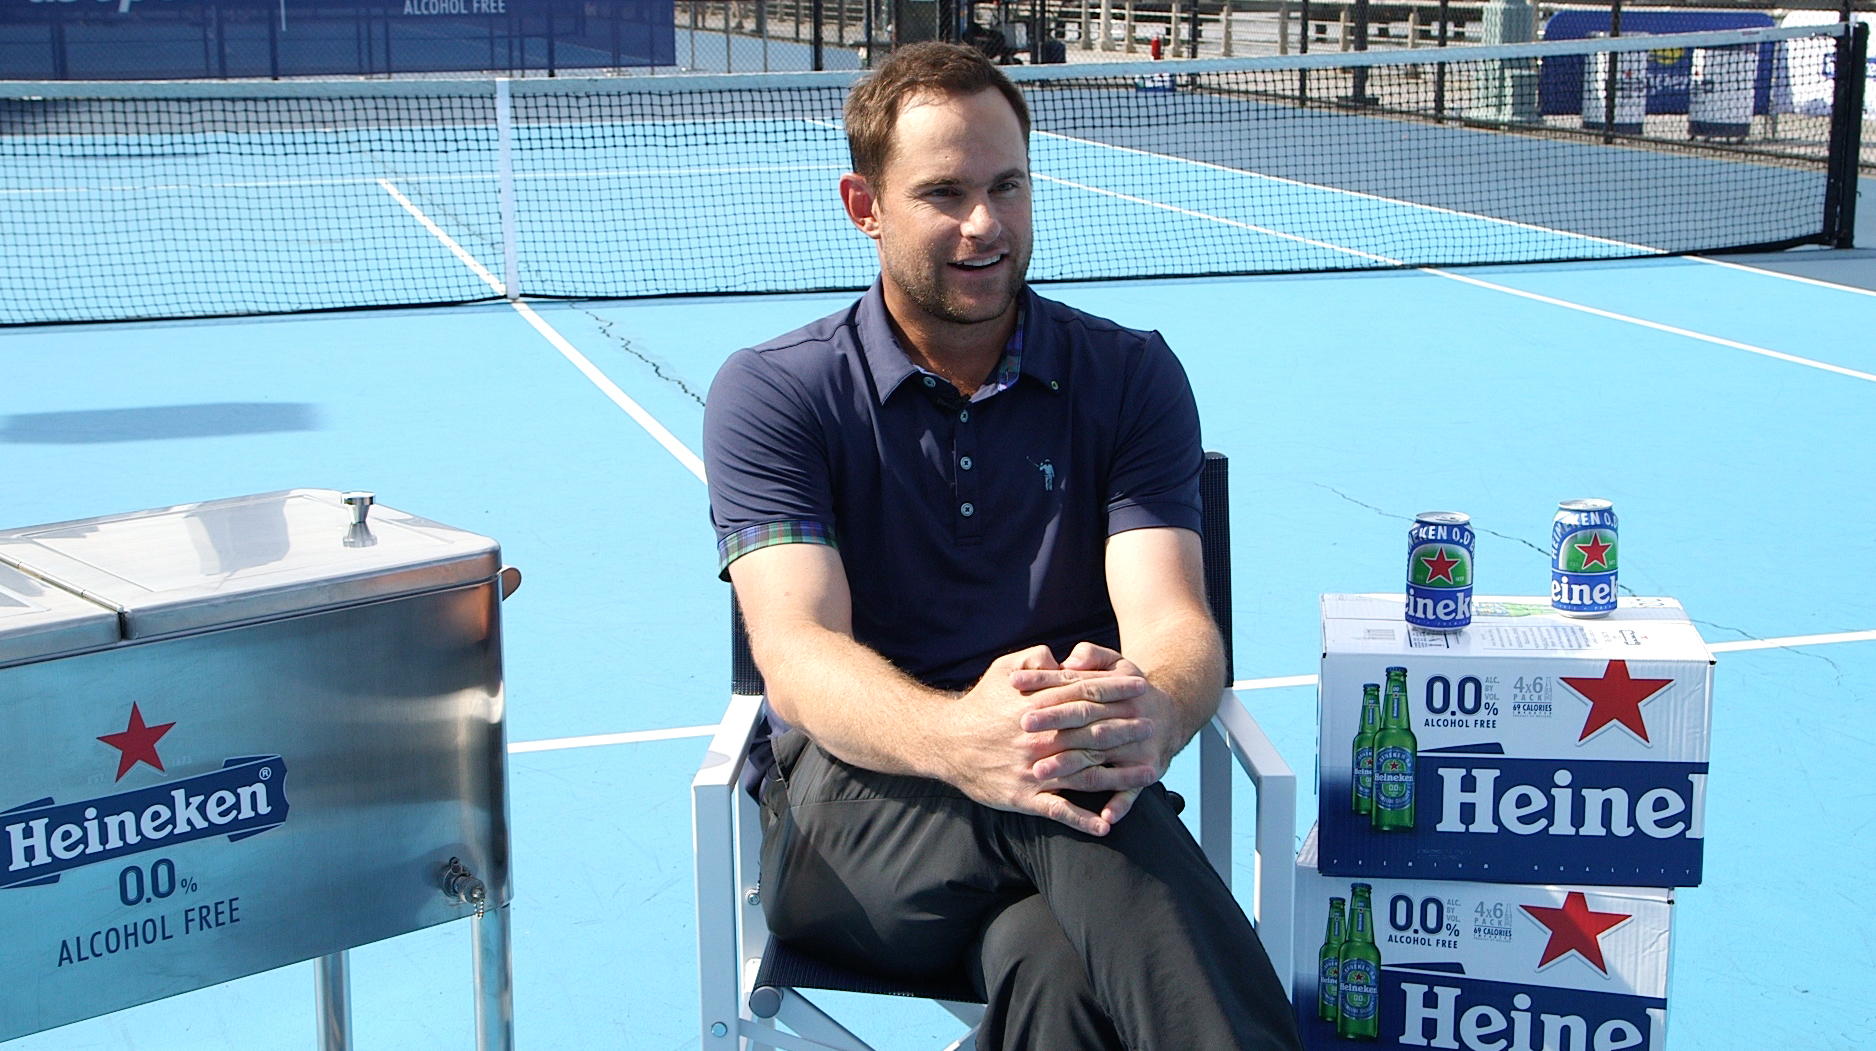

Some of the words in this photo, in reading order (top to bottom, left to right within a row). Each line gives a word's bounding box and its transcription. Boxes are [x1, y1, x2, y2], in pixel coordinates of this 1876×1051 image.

[403, 0, 468, 14] ALCOHOL
[473, 0, 506, 13] FREE
[1408, 525, 1447, 553] NEKEN
[1452, 527, 1471, 545] 0.0
[1405, 588, 1471, 621] inek
[1484, 676, 1499, 684] ALC.
[1484, 693, 1500, 701] VOL.
[1522, 704, 1552, 712] CALORIES
[1424, 719, 1470, 728] ALCOHOL
[1474, 720, 1497, 728] FREE
[1374, 773, 1414, 782] Heineken
[1474, 918, 1502, 927] PACK
[57, 916, 173, 967] ALCOHOL
[184, 897, 240, 935] FREE
[1483, 928, 1512, 937] CALORIES
[1388, 934, 1432, 946] ALCOHOL
[1436, 939, 1458, 949] FREE
[1339, 983, 1378, 993] Heineken
